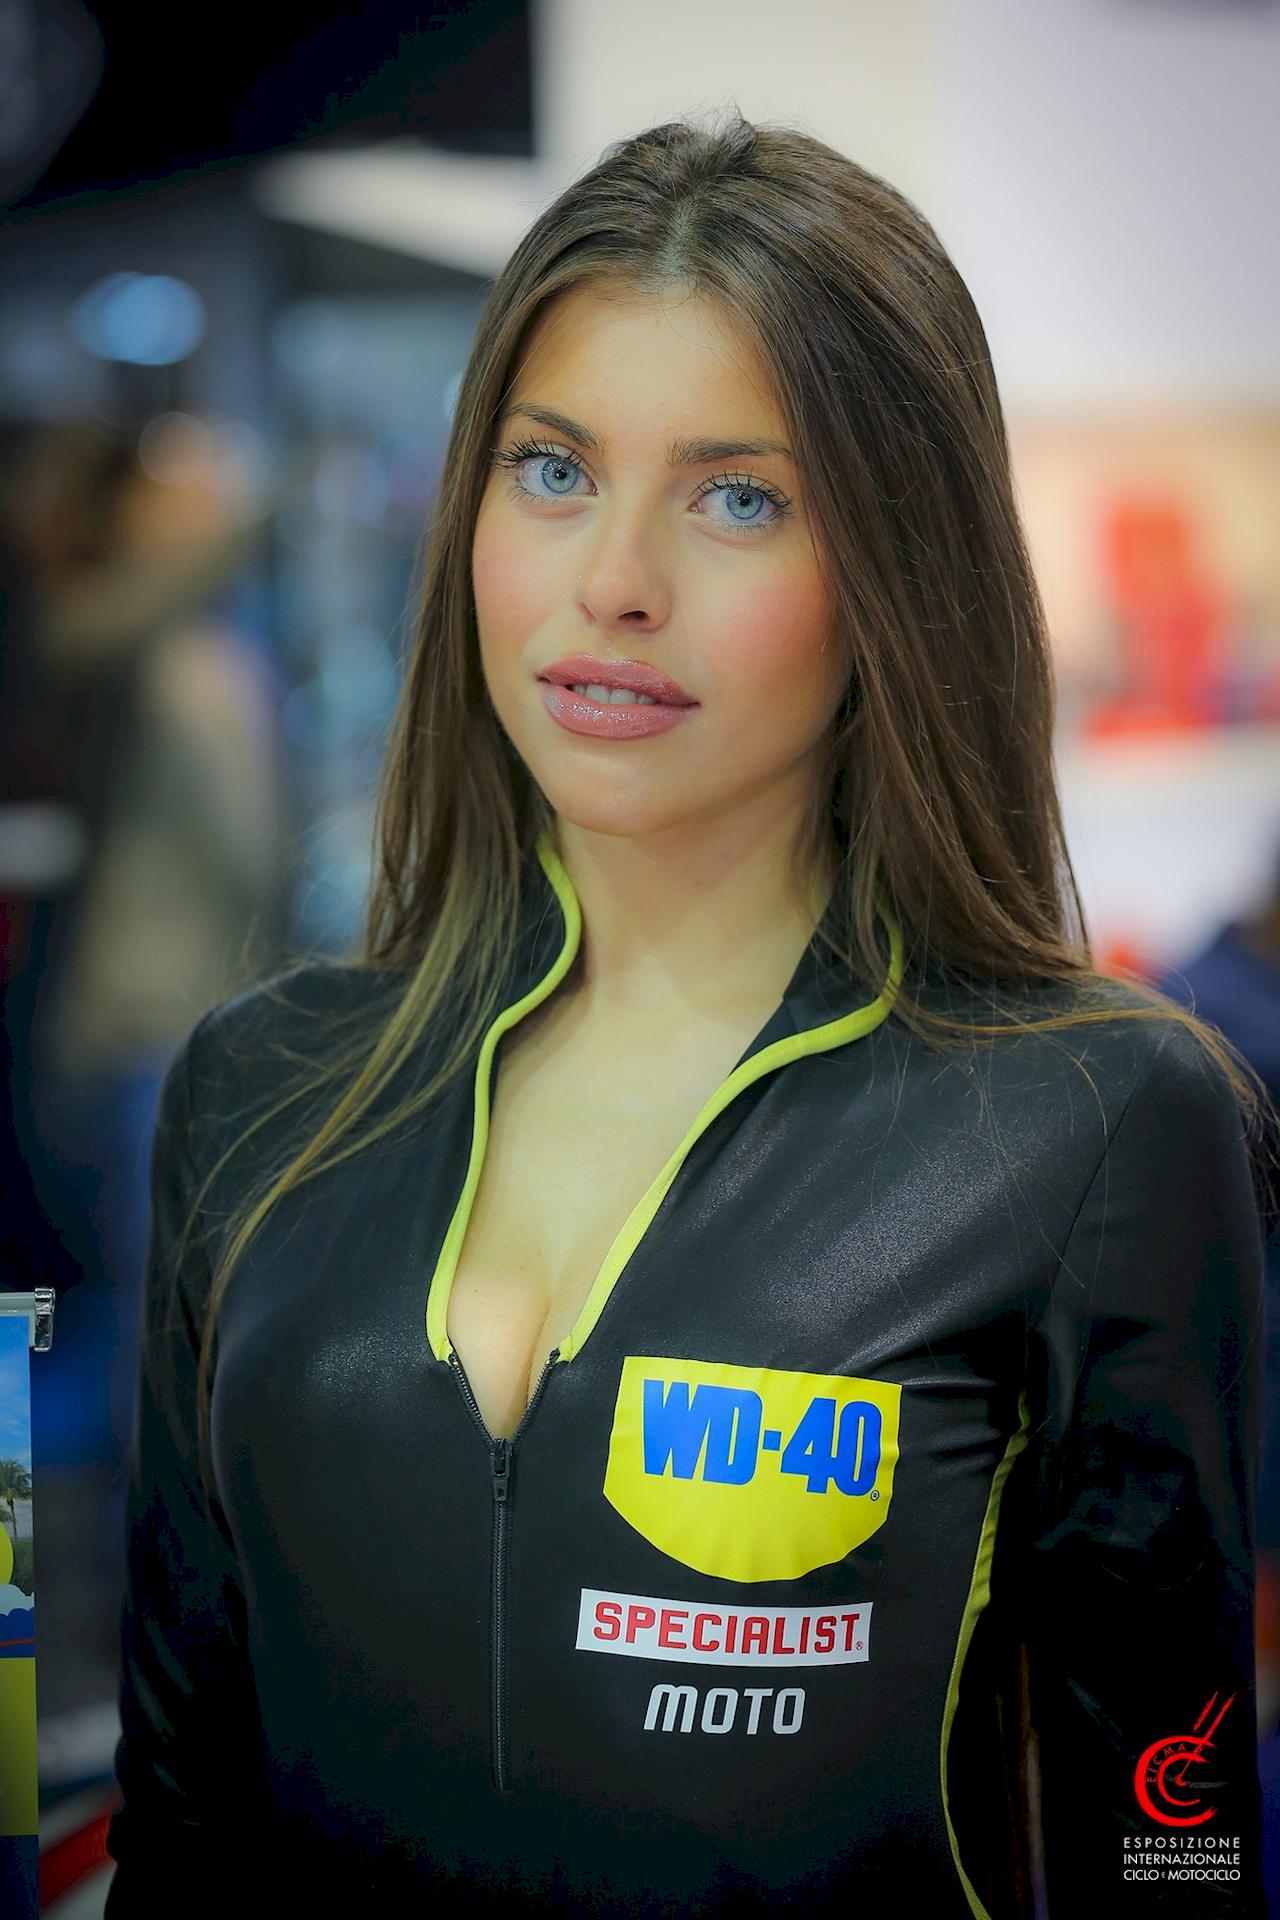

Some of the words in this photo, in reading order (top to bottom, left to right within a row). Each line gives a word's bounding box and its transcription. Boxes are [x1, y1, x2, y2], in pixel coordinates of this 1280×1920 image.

[644, 1379, 882, 1496] WD-40
[594, 1601, 860, 1655] SPECIALIST
[643, 1683, 806, 1735] MOTO
